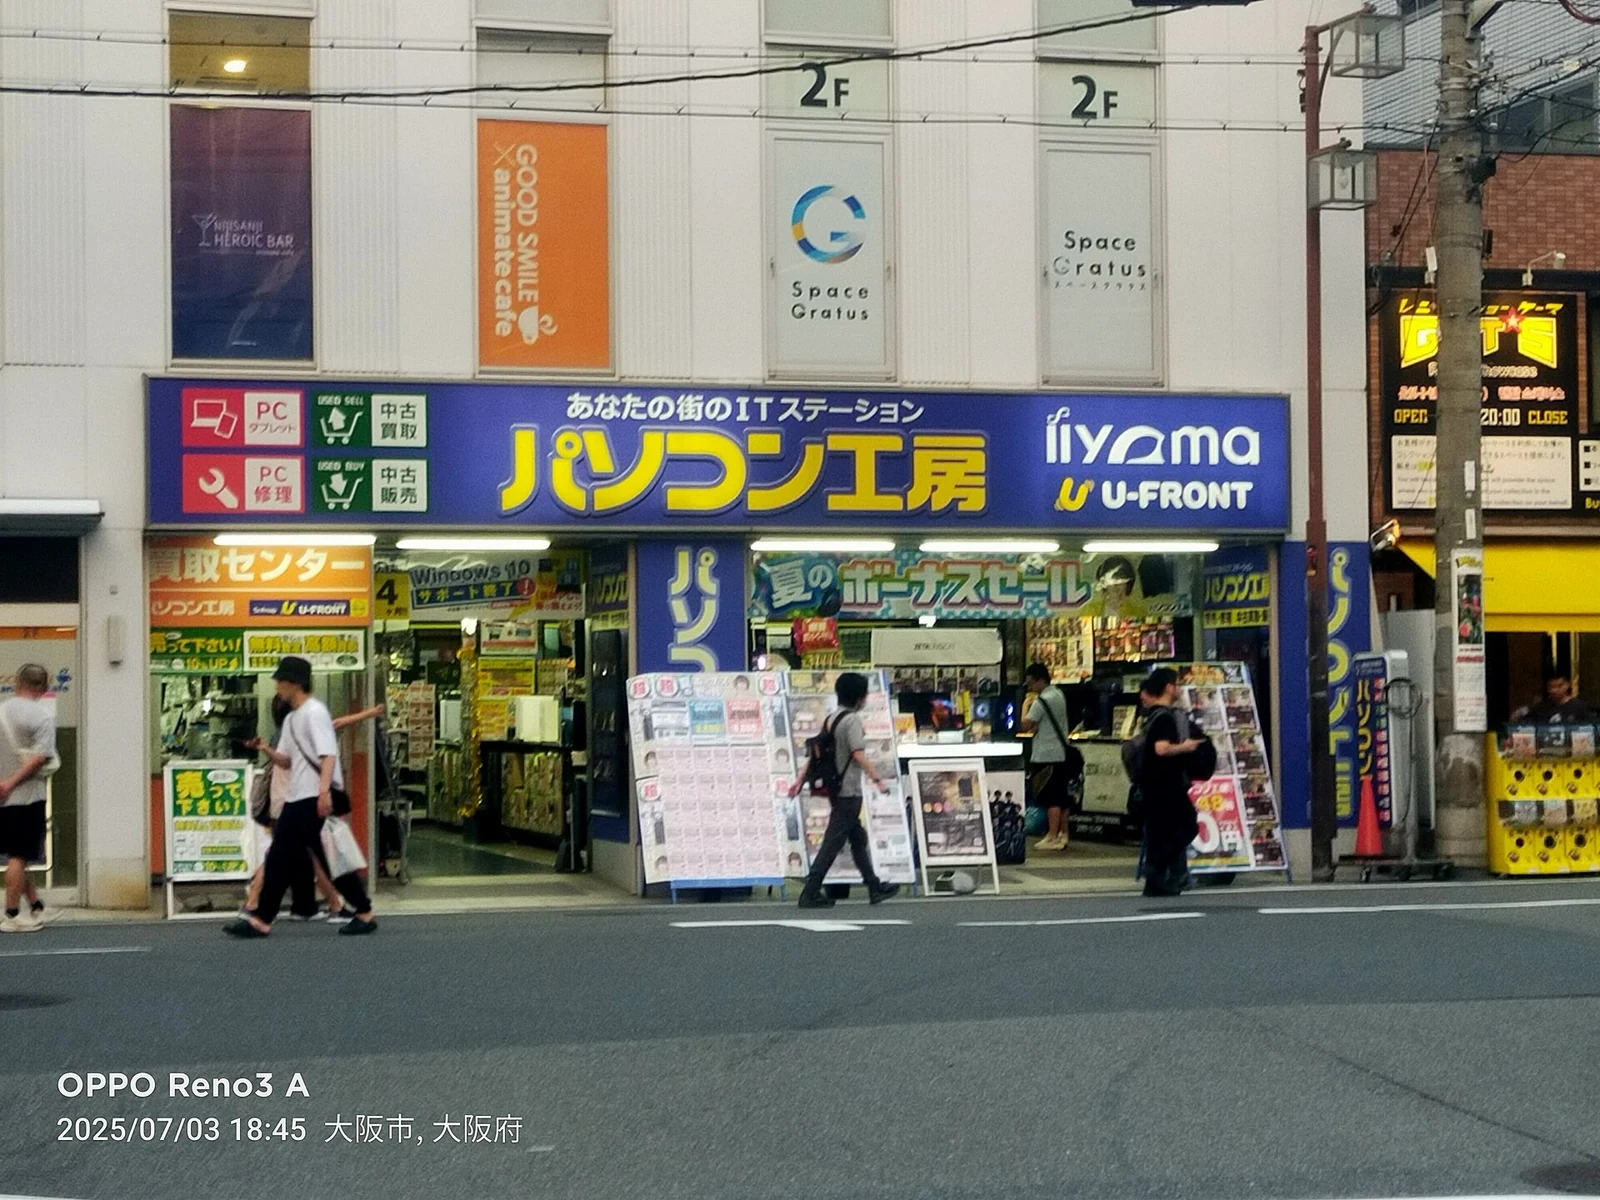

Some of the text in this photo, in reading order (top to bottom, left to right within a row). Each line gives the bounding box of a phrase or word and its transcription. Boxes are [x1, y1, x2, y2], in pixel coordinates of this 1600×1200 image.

[800, 62, 850, 107] 2F
[1071, 75, 1119, 119] 2F
[516, 144, 539, 302] GOOD SMILE
[214, 233, 294, 248] HEROIC BAR
[1064, 230, 1136, 253] Space
[1053, 255, 1146, 277] Gratus
[792, 280, 869, 300] Space
[791, 303, 869, 321] Gratus
[256, 401, 288, 420] PC
[380, 402, 417, 420] 中古
[1528, 411, 1568, 425] CLOSE
[248, 423, 297, 434] タブレット
[380, 422, 417, 440] 買取
[1046, 407, 1260, 466] iiyama
[259, 466, 288, 482] PC
[380, 466, 417, 484] 中古
[499, 427, 989, 514] パソコン工房
[253, 486, 293, 504] 修理
[380, 486, 418, 505] 販売
[1101, 480, 1254, 510] U-FRONT
[409, 564, 501, 590] Windows
[764, 558, 833, 609] 夏の
[840, 560, 1089, 608] ボーナスセール
[375, 578, 399, 606] 4
[1357, 679, 1373, 777] パソコン
